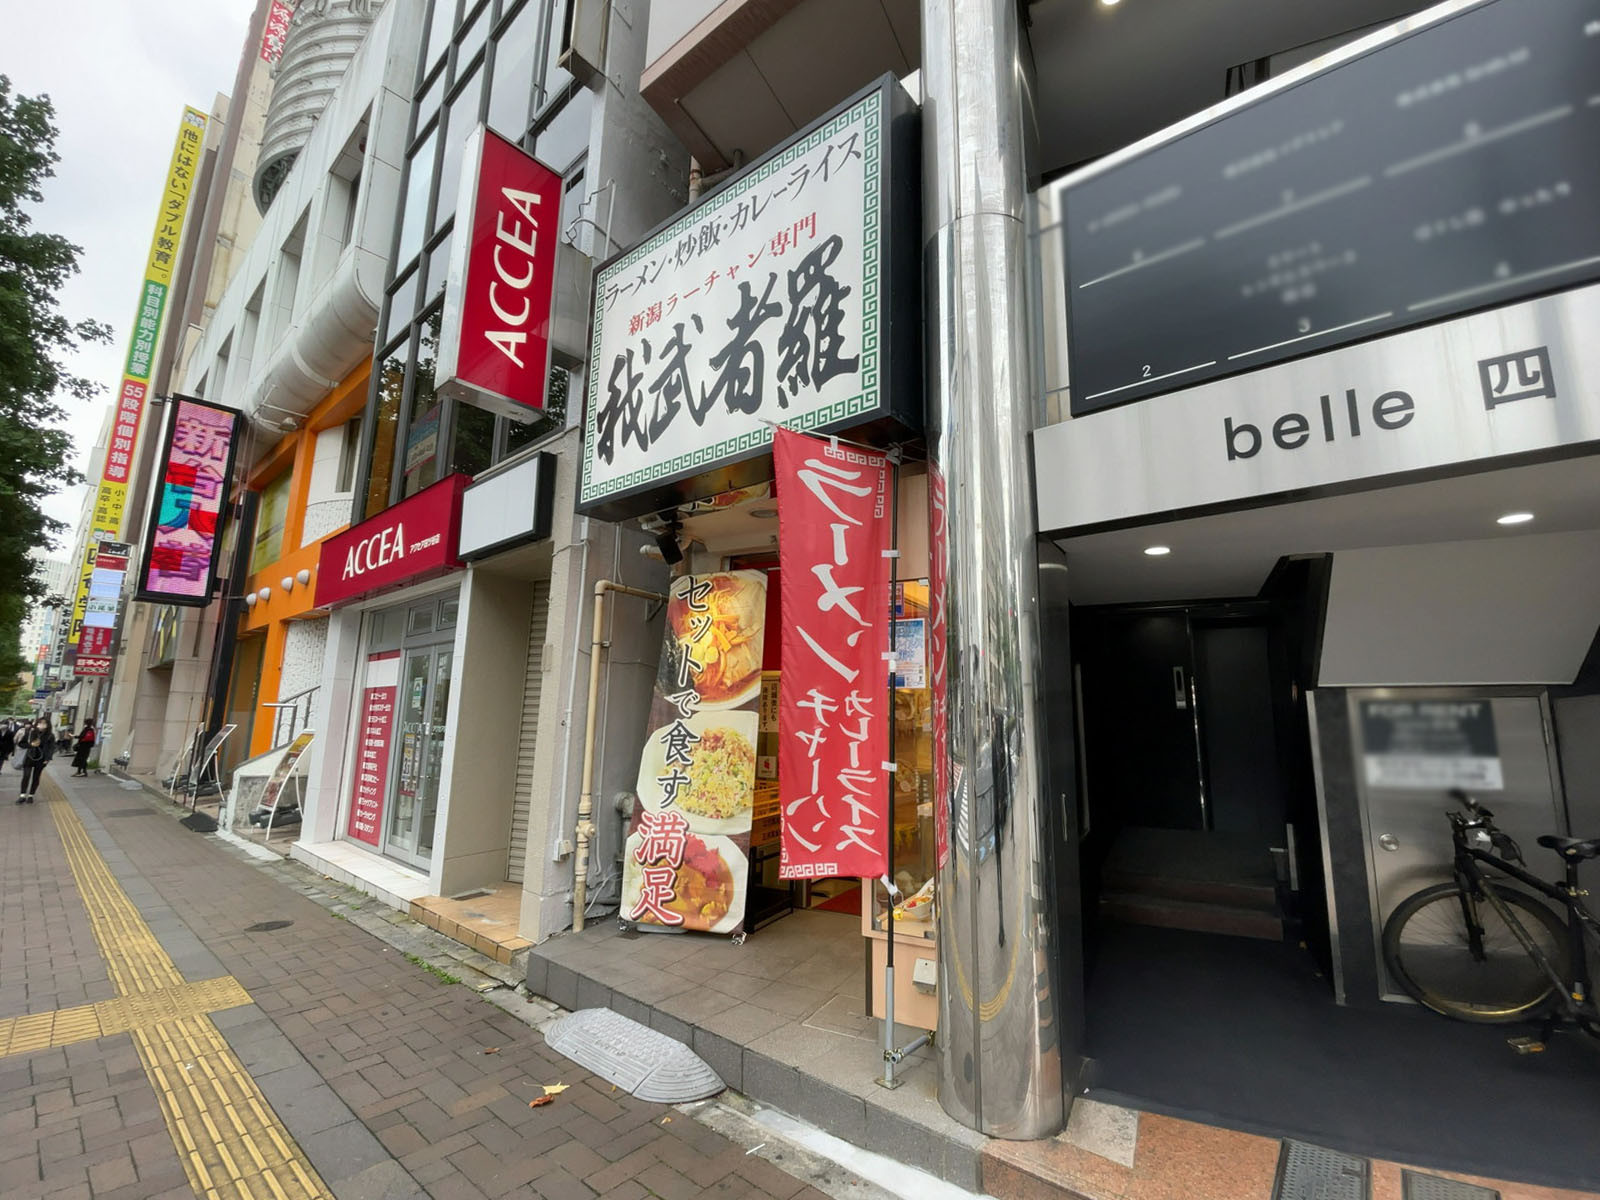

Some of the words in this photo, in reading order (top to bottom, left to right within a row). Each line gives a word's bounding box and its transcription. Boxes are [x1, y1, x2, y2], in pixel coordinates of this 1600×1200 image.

[152, 128, 198, 278] 他にはない「ダブル教育」。
[605, 132, 862, 312] ラーメン・炒飯・カレーライス
[130, 284, 164, 376] 科目別能力別授業
[484, 187, 541, 369] ACCEA
[628, 212, 817, 336] 新潟ラーチャン専門
[597, 234, 860, 466] 我武者羅
[1142, 364, 1152, 378] 2
[1223, 388, 1416, 462] belle
[1477, 345, 1557, 411] 四
[107, 384, 144, 478] 55段階個別指導
[151, 416, 231, 582] 新台入替
[342, 522, 405, 581] ACCEA
